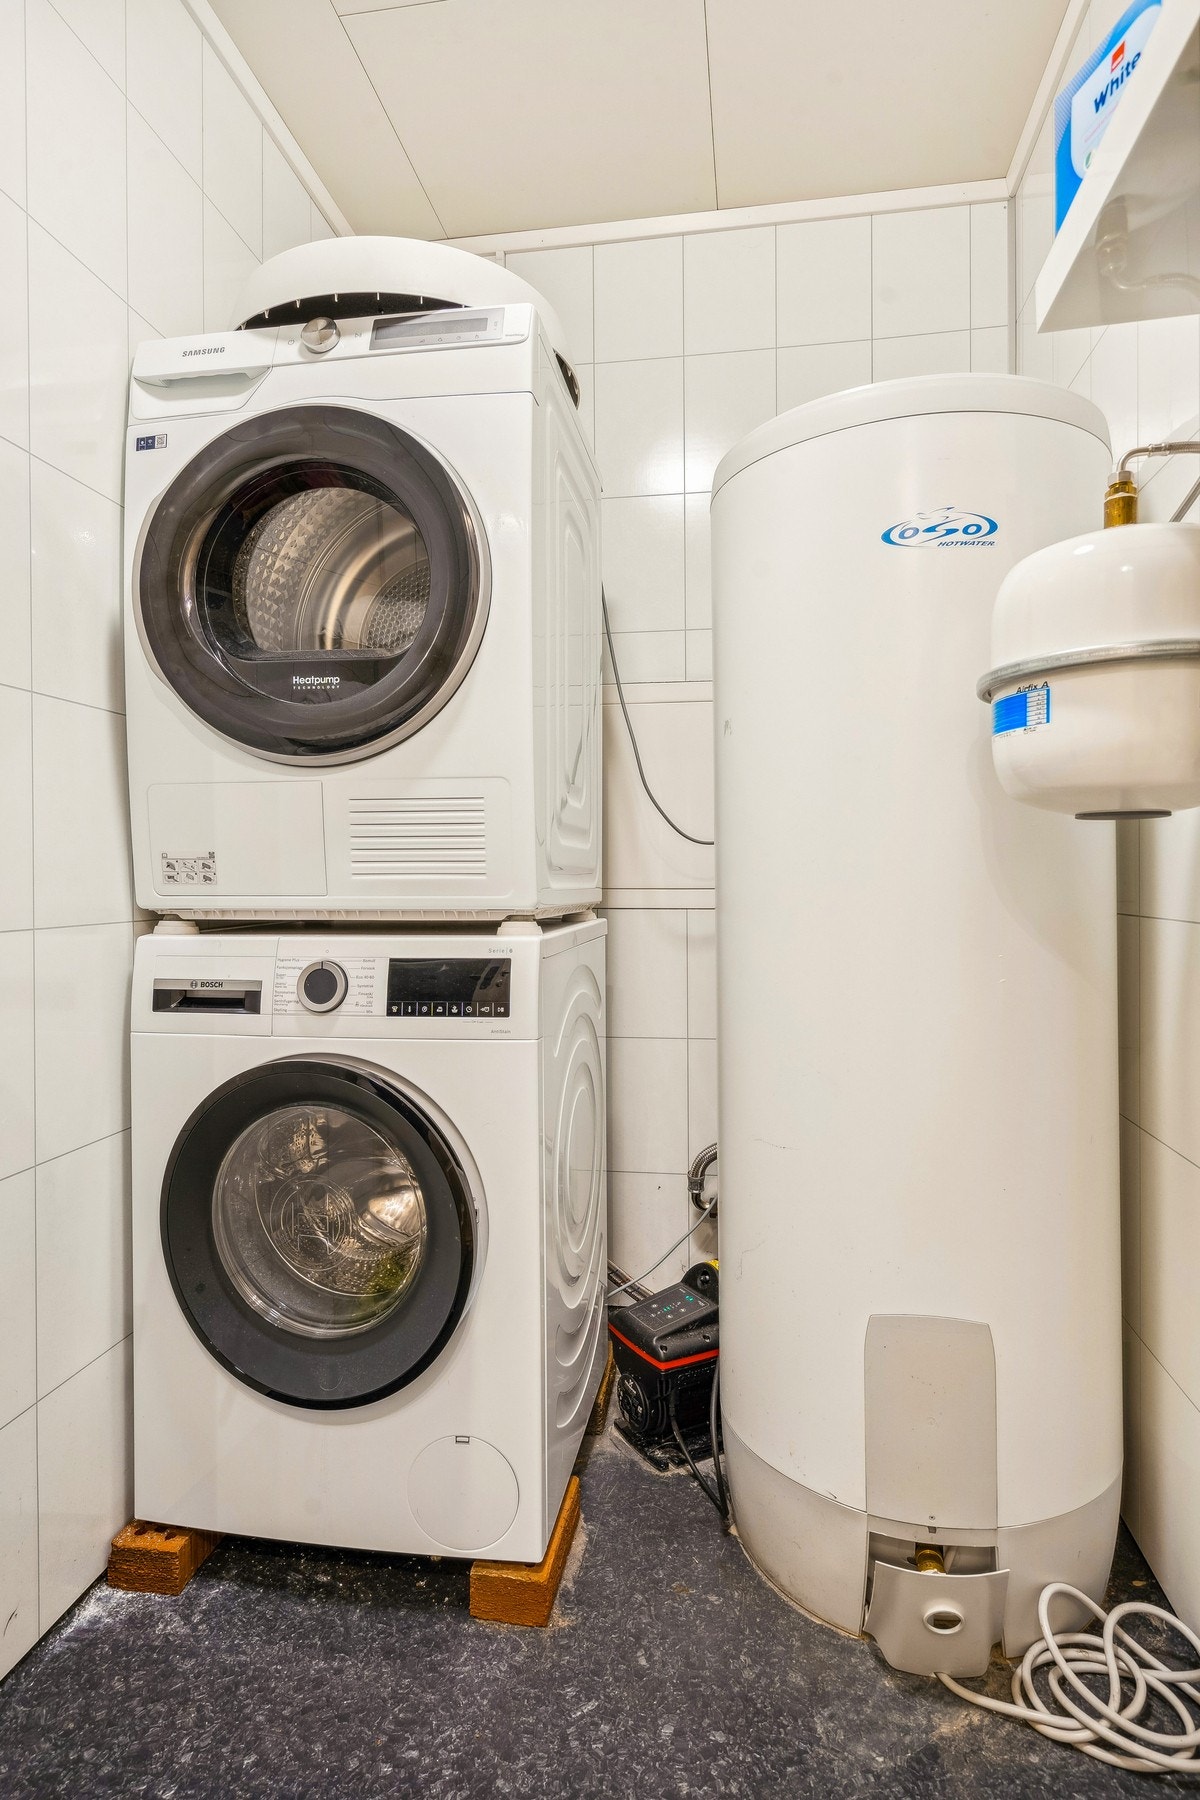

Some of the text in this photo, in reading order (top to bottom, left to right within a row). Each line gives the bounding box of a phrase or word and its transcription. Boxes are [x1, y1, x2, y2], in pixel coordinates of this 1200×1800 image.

[1094, 51, 1142, 114] White
[182, 346, 226, 357] SAMSUNG
[292, 675, 340, 685] Heatpump
[1016, 683, 1039, 694] Airfix
